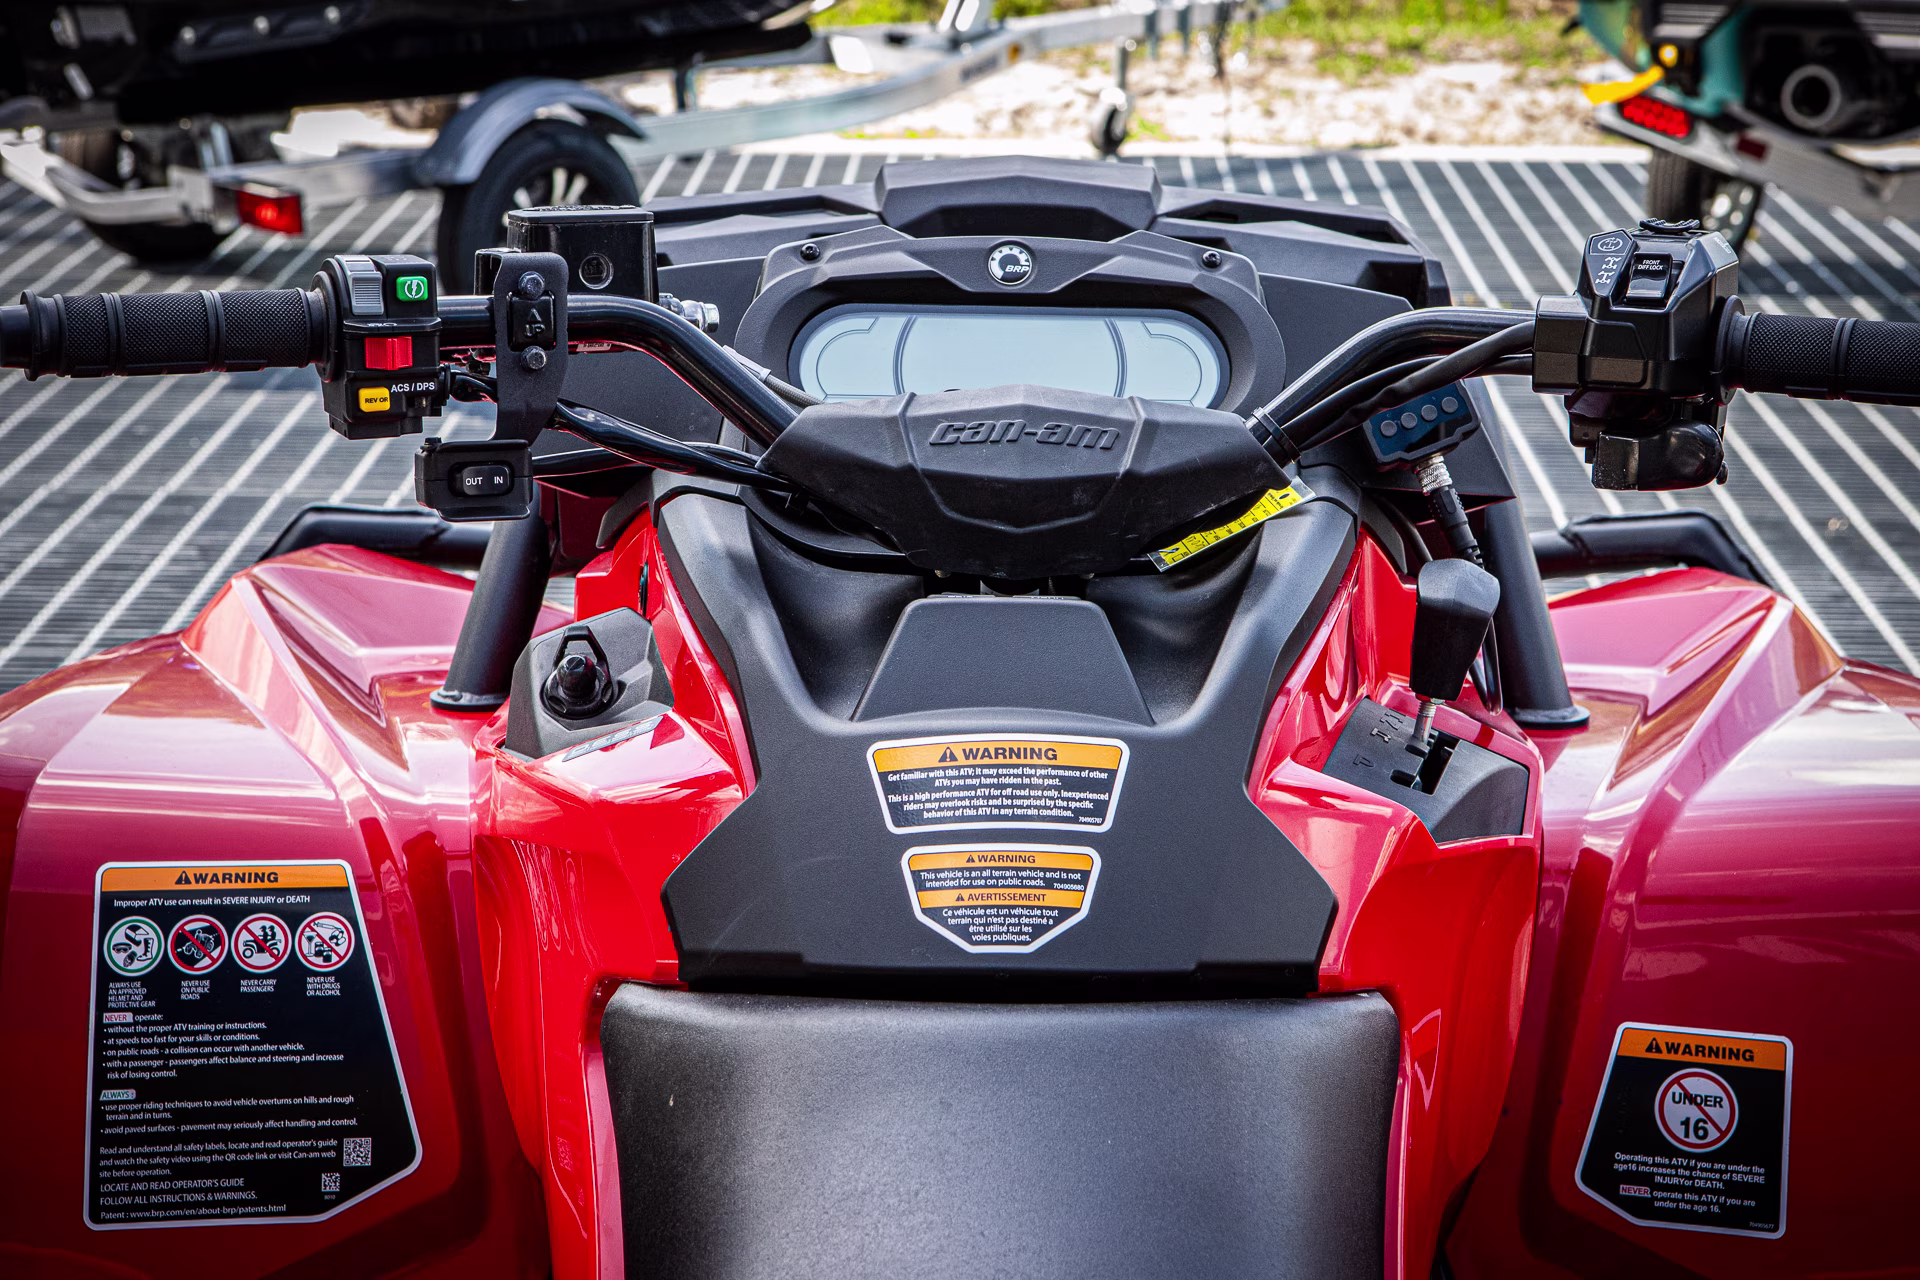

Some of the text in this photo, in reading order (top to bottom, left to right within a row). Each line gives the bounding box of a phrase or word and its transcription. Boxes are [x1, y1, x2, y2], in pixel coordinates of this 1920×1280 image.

[1005, 264, 1030, 273] BRP
[525, 324, 545, 336] UP
[390, 383, 410, 393] ACS
[416, 382, 435, 391] DPS
[928, 419, 1120, 450] can-am
[465, 476, 503, 486] OUT IN
[962, 747, 1058, 761] WARNING
[900, 771, 927, 780] familiar
[928, 769, 944, 777] with
[945, 768, 958, 776] this
[959, 767, 974, 776] ATV;
[975, 767, 981, 775] it
[982, 768, 997, 777] may
[998, 766, 1022, 775] exceed
[1023, 766, 1035, 775] the
[1036, 767, 1080, 777] performance
[1080, 769, 1088, 777] of
[1089, 770, 1108, 778] other
[934, 778, 950, 786] ATVs
[951, 778, 964, 787] you
[964, 778, 980, 786] may
[998, 776, 1022, 784] ridden
[1022, 776, 1030, 784] in
[1030, 776, 1043, 784] the
[1043, 778, 1061, 786] past.
[978, 854, 1036, 864] WARNING
[194, 872, 278, 885] WARNING
[921, 871, 935, 880] This
[936, 870, 962, 879] vehicle
[1017, 869, 1044, 877] vehicle
[925, 878, 959, 887] intended
[960, 877, 970, 886] for
[998, 877, 1021, 886] public
[114, 899, 147, 908] Improper
[148, 897, 163, 905] ATV
[192, 896, 212, 905] result
[222, 896, 248, 904] SEVERE
[249, 895, 275, 903] INJURY
[285, 895, 310, 903] DEATH
[967, 892, 1046, 902] AVERTISSEMENT
[953, 907, 984, 915] véhicule
[1010, 907, 1041, 915] véhicule
[973, 916, 986, 925] qui
[1005, 917, 1018, 925] pas
[1019, 916, 1047, 924] destiné
[985, 924, 1007, 932] utilisé
[1021, 924, 1032, 932] les
[992, 933, 1031, 942] publiques.
[134, 1014, 164, 1022] operate:
[188, 1022, 215, 1031] training
[115, 1036, 139, 1045] speeds
[222, 1032, 259, 1040] conditions.
[1665, 1042, 1755, 1062] WARNING
[1672, 1092, 1724, 1108] UNDER
[1680, 1116, 1709, 1140] 16
[1614, 1152, 1653, 1164] Operating
[1654, 1156, 1669, 1164] this
[1671, 1157, 1688, 1166] ATV
[1613, 1163, 1636, 1171] age16
[1638, 1164, 1675, 1175] increases
[1677, 1168, 1690, 1177] the
[1691, 1169, 1720, 1179] chance
[1732, 1173, 1764, 1183] SEVERE
[100, 1178, 244, 1192] LOCATE AND READ OPERATOR'S GUIDE
[1654, 1175, 1724, 1189] INJURYor DEATH.
[100, 1191, 257, 1205] FOLLOW ALL INSTRUCTIONS & WARNINGS.
[1621, 1186, 1650, 1195] NEVER
[1652, 1190, 1682, 1201] operate
[1684, 1192, 1698, 1200] this
[1700, 1194, 1718, 1203] ATV
[129, 1204, 286, 1217] www.brp.com/en/about-brp/patents.html
[1693, 1204, 1707, 1212] age
[1710, 1204, 1720, 1212] 16.
